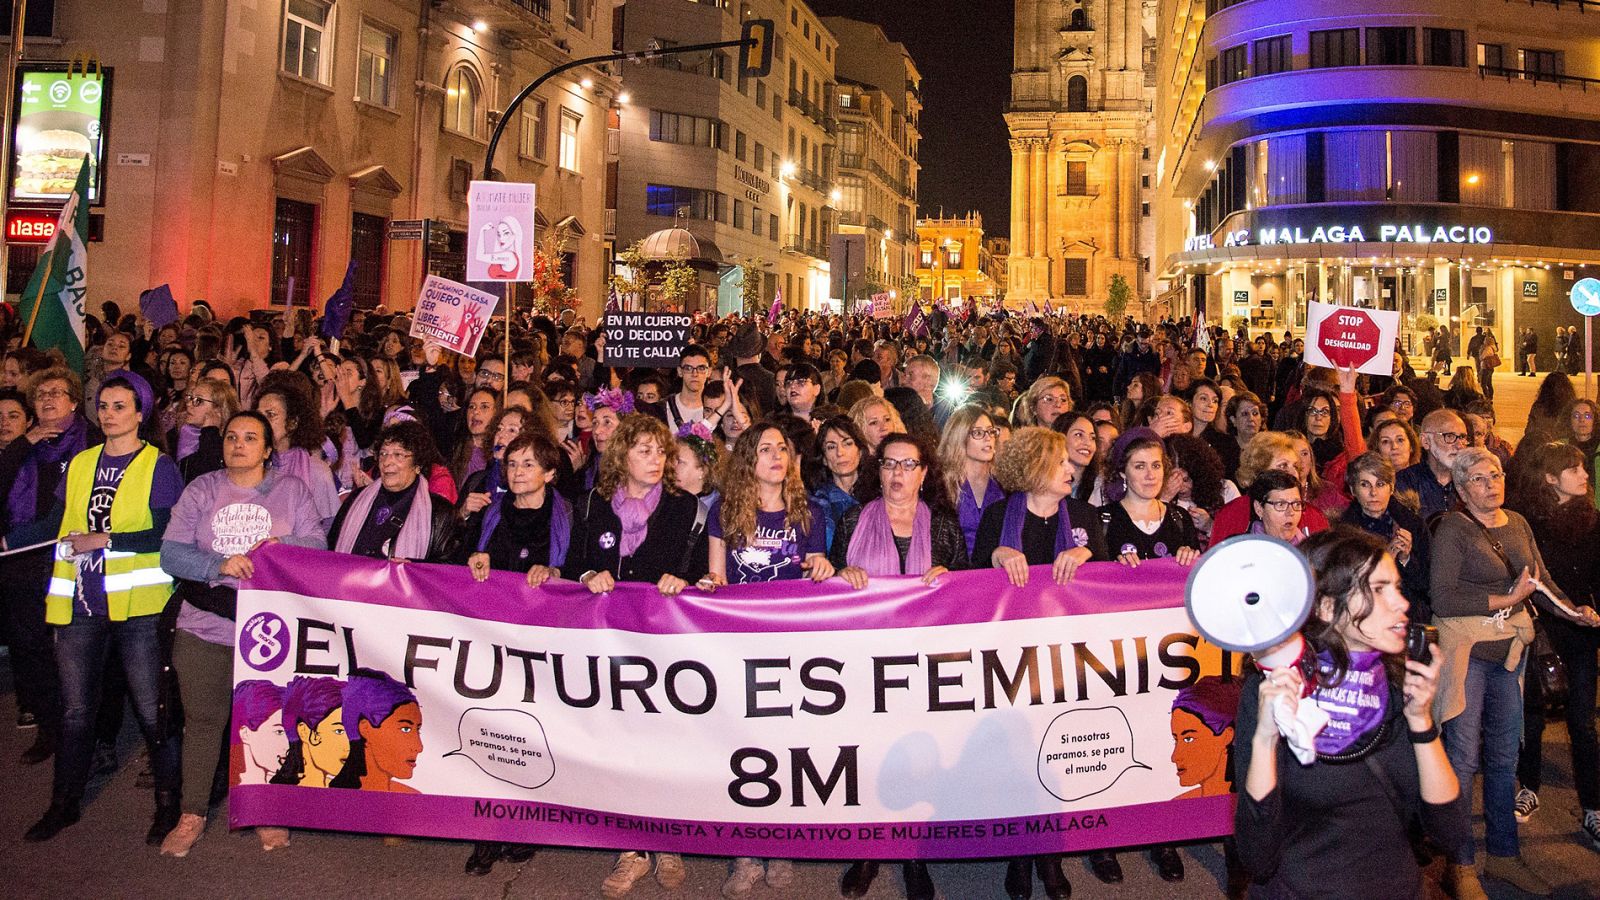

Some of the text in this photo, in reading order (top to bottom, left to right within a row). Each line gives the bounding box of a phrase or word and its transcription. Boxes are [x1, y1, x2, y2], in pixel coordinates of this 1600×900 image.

[1224, 229, 1249, 247] AC
[1260, 225, 1366, 245] MALAGA
[1380, 225, 1493, 244] PALACIO
[429, 280, 437, 288] DE
[437, 283, 464, 296] CAMINO
[470, 293, 489, 306] CASA
[1437, 290, 1447, 298] AC
[1524, 283, 1537, 292] AC
[425, 289, 460, 307] QUIERO
[420, 300, 436, 312] SER
[607, 315, 691, 327] EN MI CUERPO
[1338, 314, 1363, 327] STOP
[606, 329, 685, 341] YO DECIDO Y
[1341, 331, 1356, 340] A LA
[606, 344, 624, 358] TÚ
[625, 347, 640, 358] TE
[1324, 338, 1371, 351] DESIGUALDAD
[293, 617, 1233, 718] EL FUTURO ES FEMINIST
[480, 728, 526, 743] Si nosotras
[1061, 732, 1110, 744] Si nosotras
[521, 749, 542, 758] para
[1091, 749, 1101, 757] se
[1103, 746, 1125, 758] para
[488, 753, 526, 767] el mundo
[1065, 761, 1107, 775] el mundo
[727, 744, 861, 807] 8M
[473, 800, 599, 826] MOVIMIENTO
[604, 815, 706, 837] FEMINISTA
[713, 825, 724, 837] Y
[731, 827, 851, 841] ASOCIATIVO
[858, 827, 886, 840] DE
[891, 825, 987, 840] MUJERES
[993, 823, 1018, 836] DE
